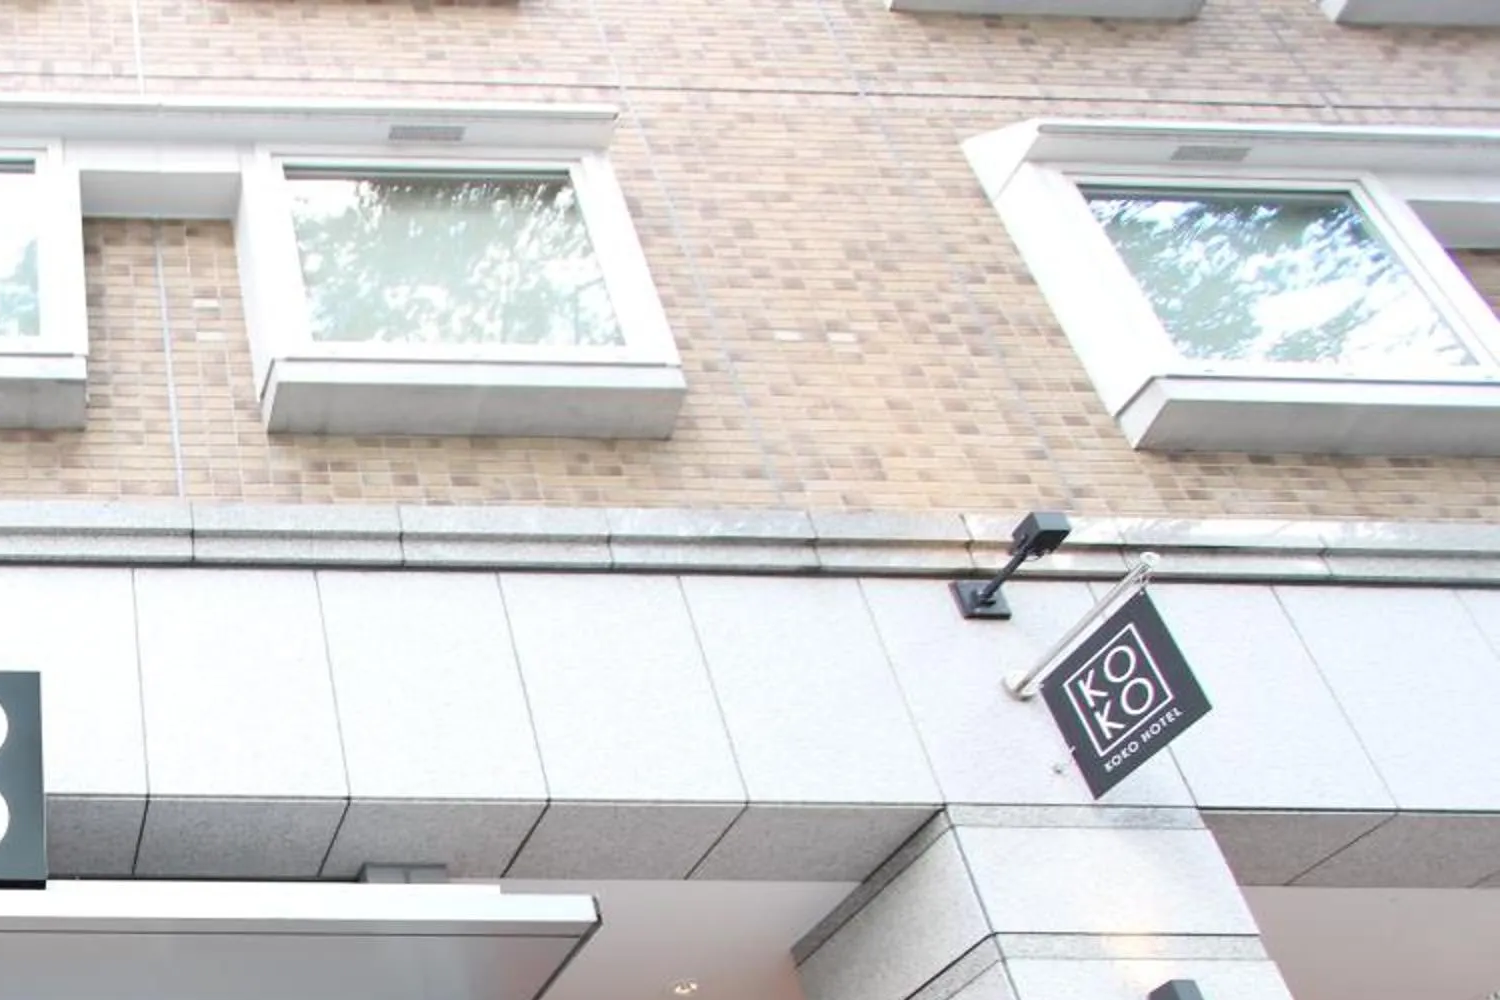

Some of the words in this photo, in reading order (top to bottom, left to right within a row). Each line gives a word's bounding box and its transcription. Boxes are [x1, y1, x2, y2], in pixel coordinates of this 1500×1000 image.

[1078, 645, 1137, 707] KO
[1095, 677, 1155, 740] KO
[1104, 741, 1139, 773] KOKO
[1140, 707, 1184, 743] HOTEL
